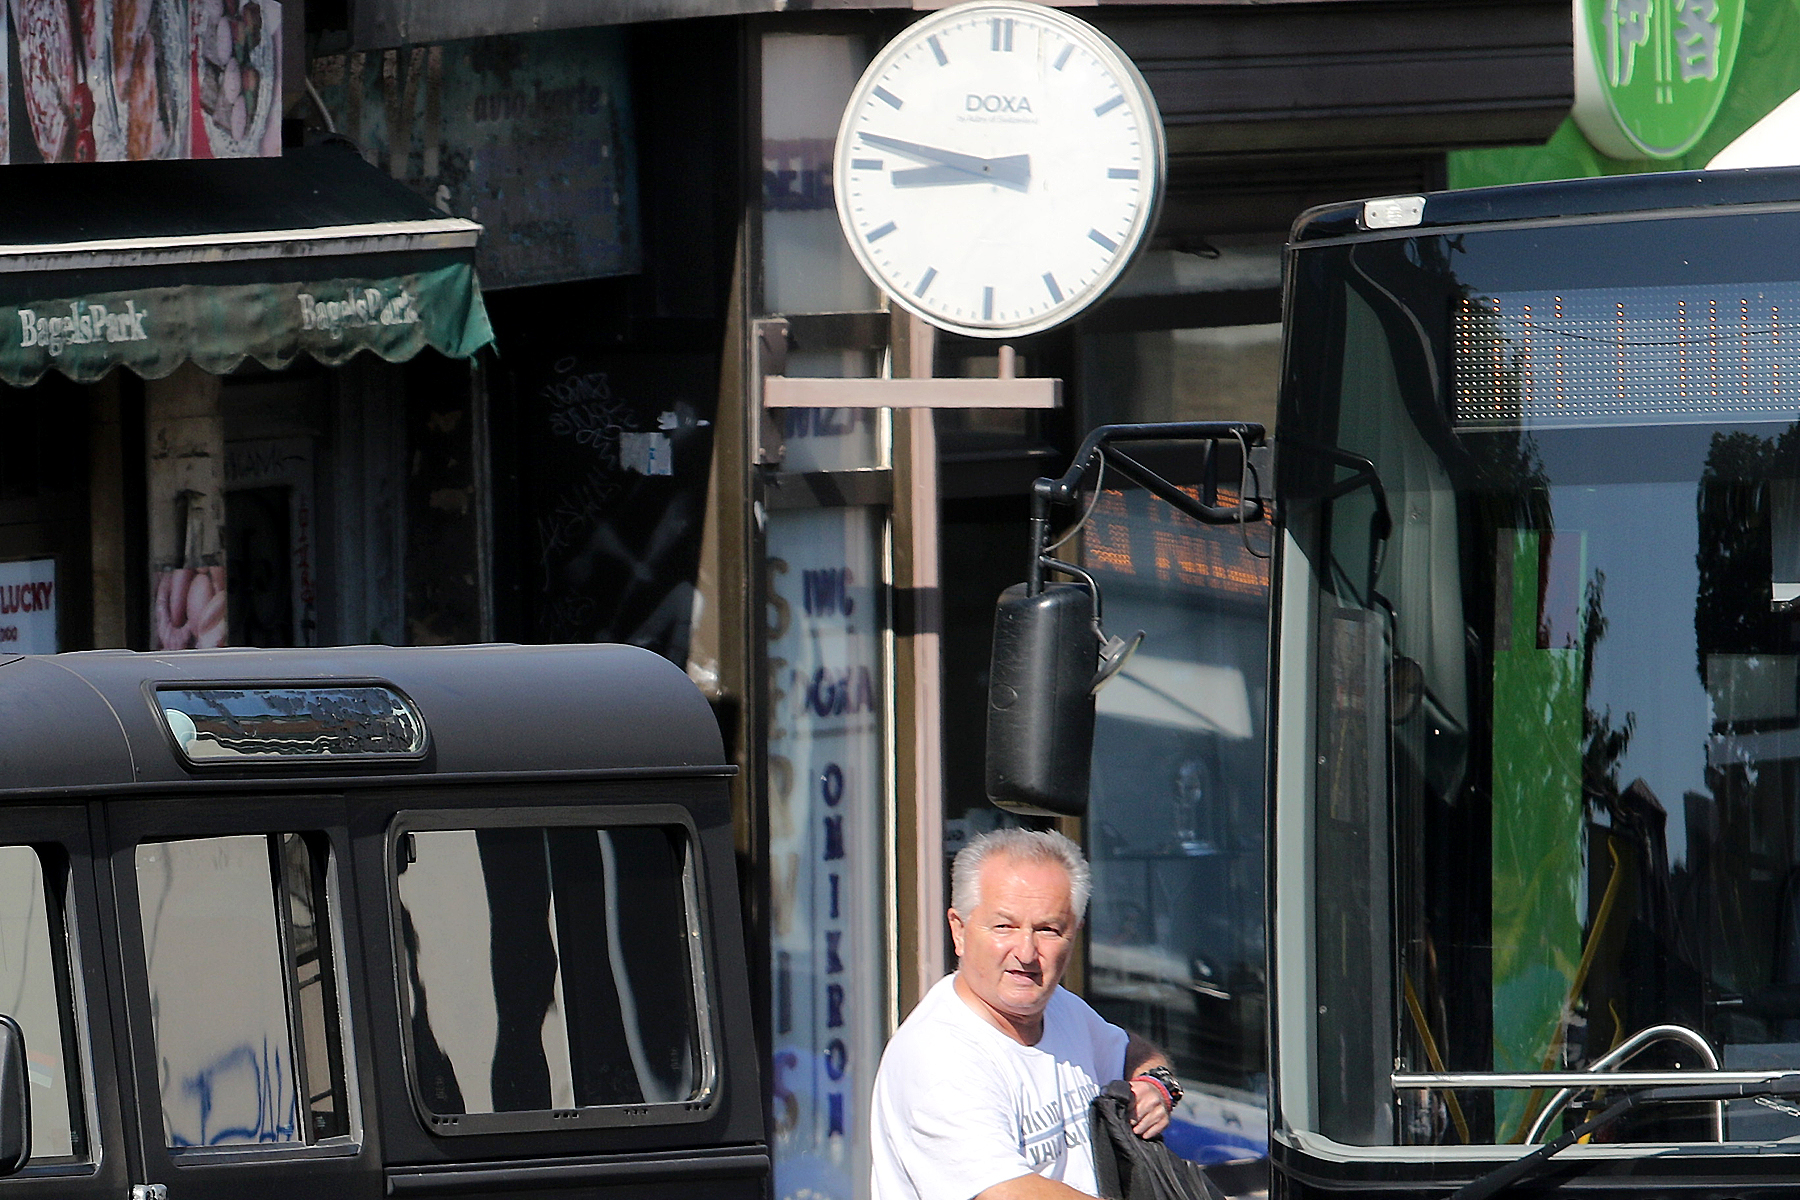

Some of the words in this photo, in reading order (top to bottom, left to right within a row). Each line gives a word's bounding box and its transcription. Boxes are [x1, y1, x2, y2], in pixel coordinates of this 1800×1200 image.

[966, 94, 1033, 112] DOXA
[18, 299, 149, 358] BagelsPark
[0, 581, 54, 614] LUCKY
